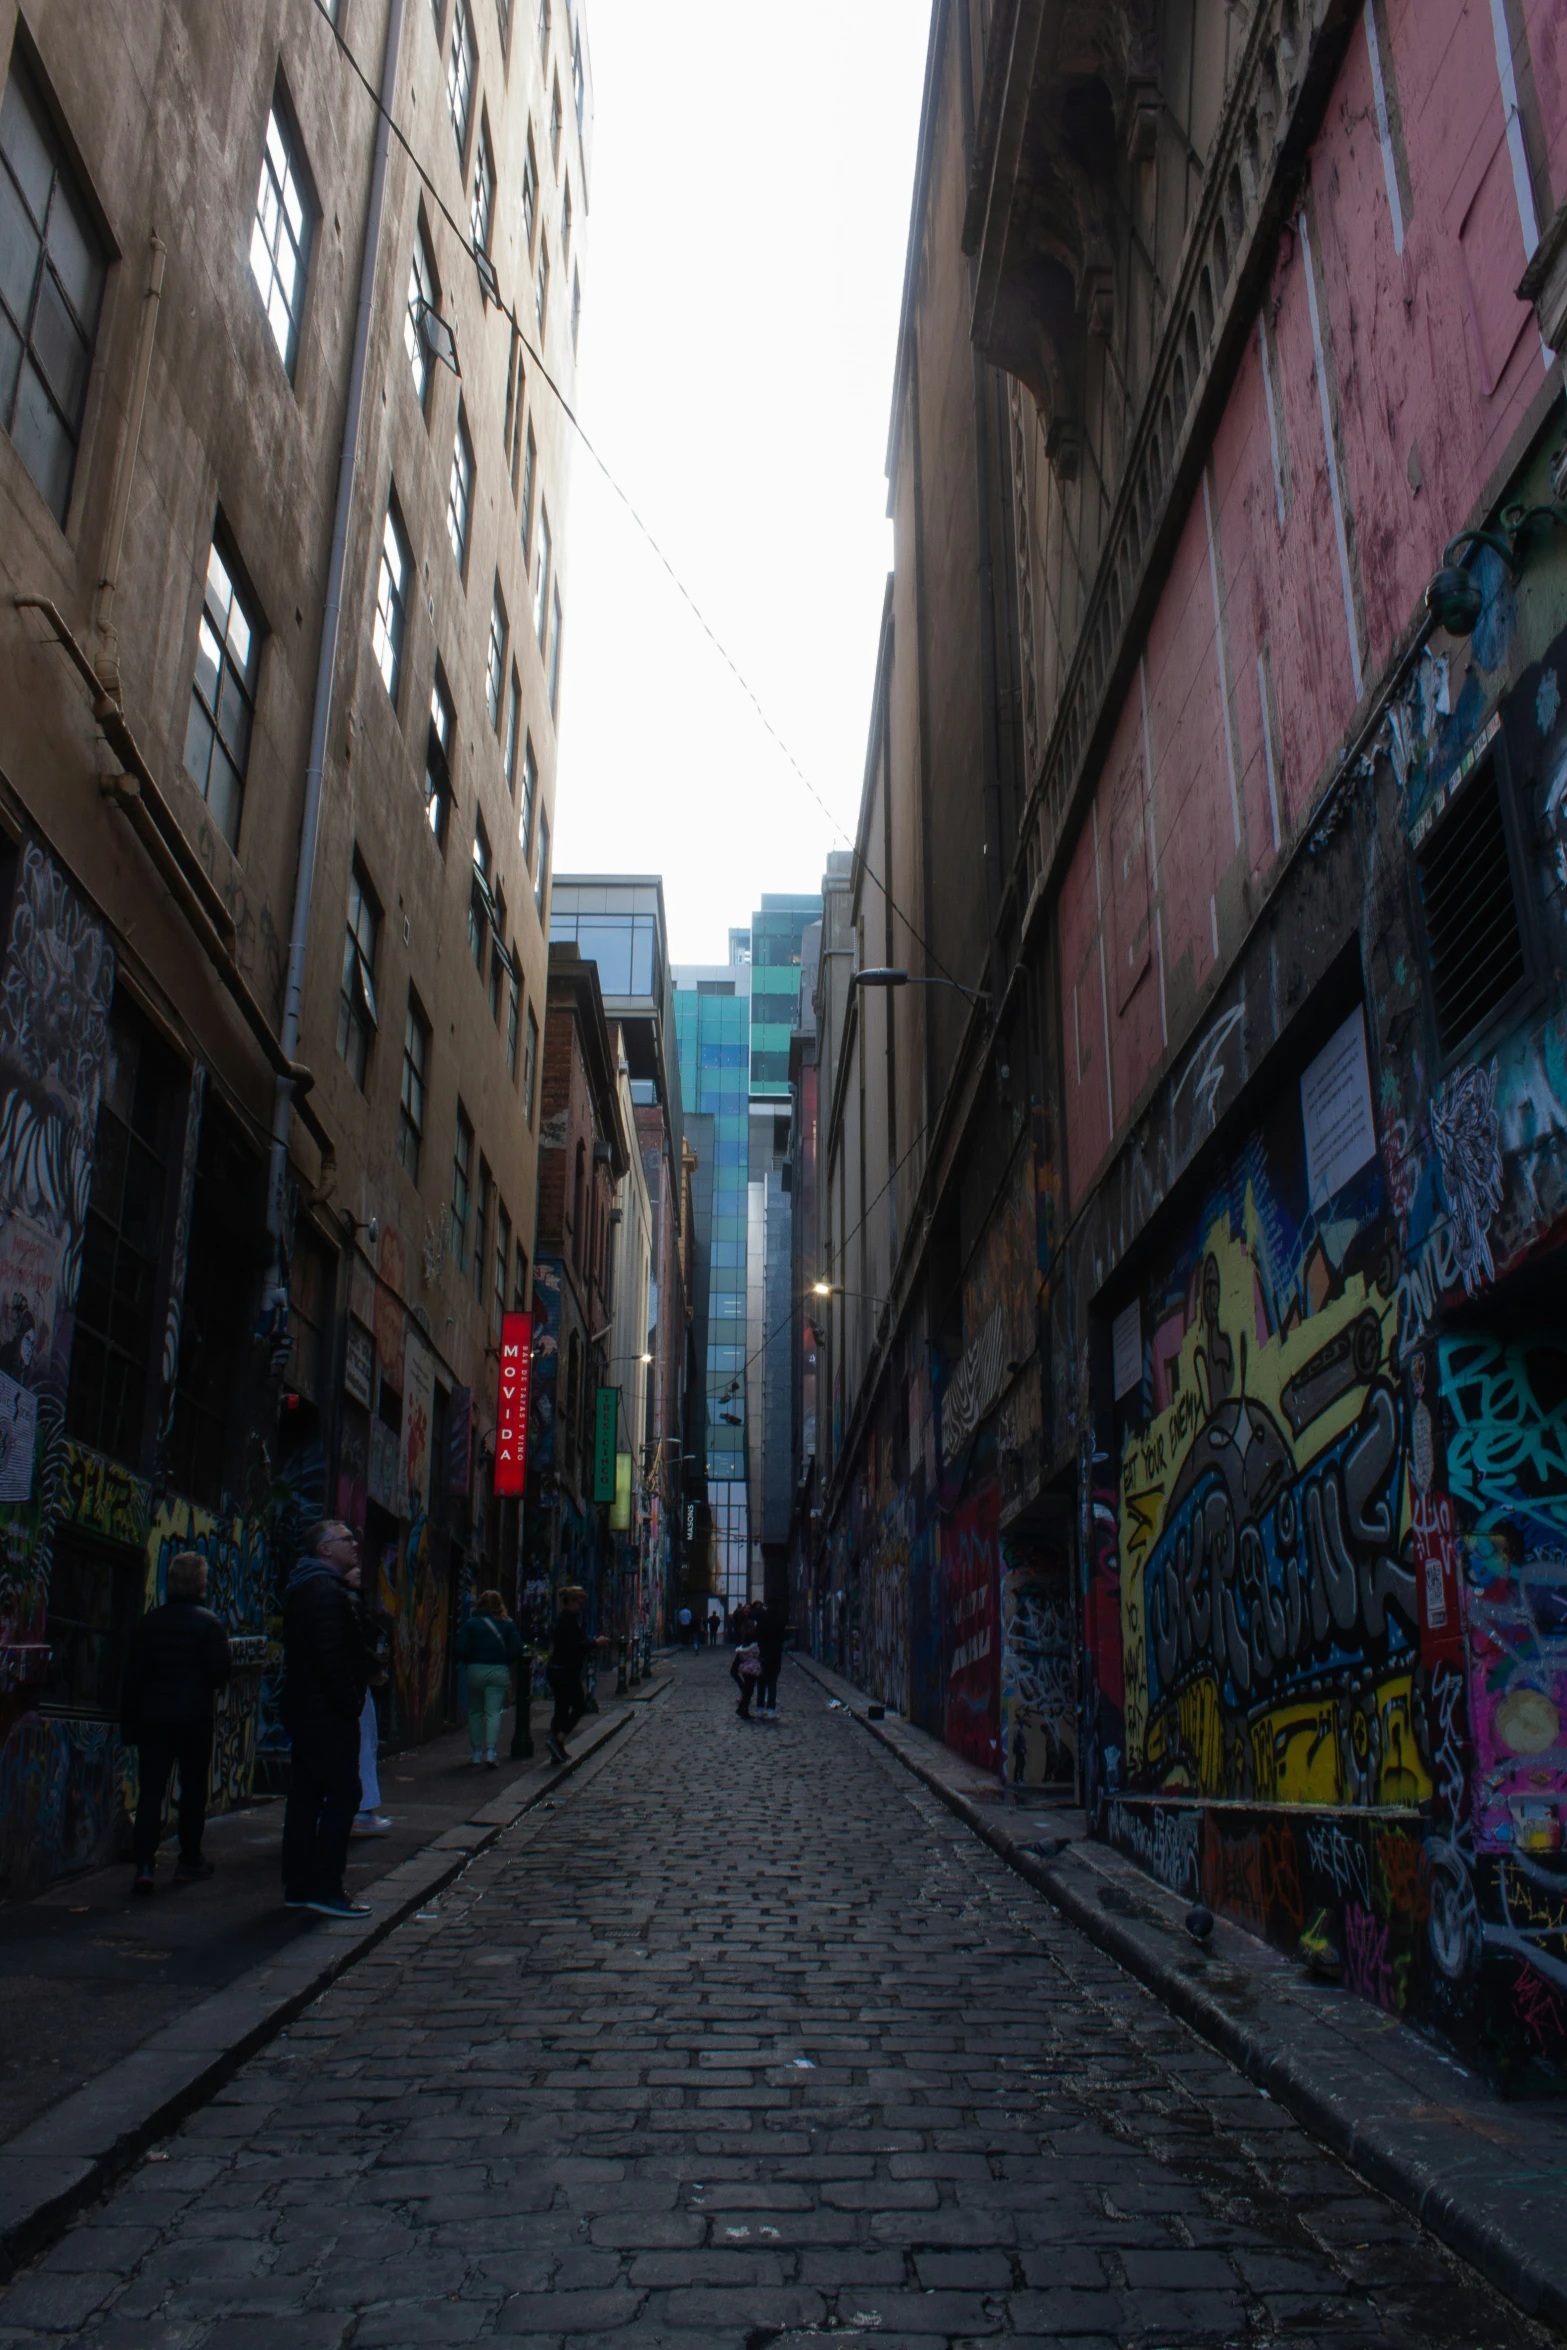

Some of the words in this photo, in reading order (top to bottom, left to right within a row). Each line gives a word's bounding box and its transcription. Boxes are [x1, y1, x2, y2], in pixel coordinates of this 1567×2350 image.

[520, 1370, 528, 1382] DE
[500, 1345, 518, 1461] MOVIDA
[518, 1388, 527, 1418] TAPAS
[602, 1394, 610, 1430] TRES
[517, 1435, 525, 1461] VINO
[1124, 1452, 1137, 1493] EAT
[1141, 1433, 1167, 1480] YOUR
[1169, 1390, 1203, 1460] ENEMY
